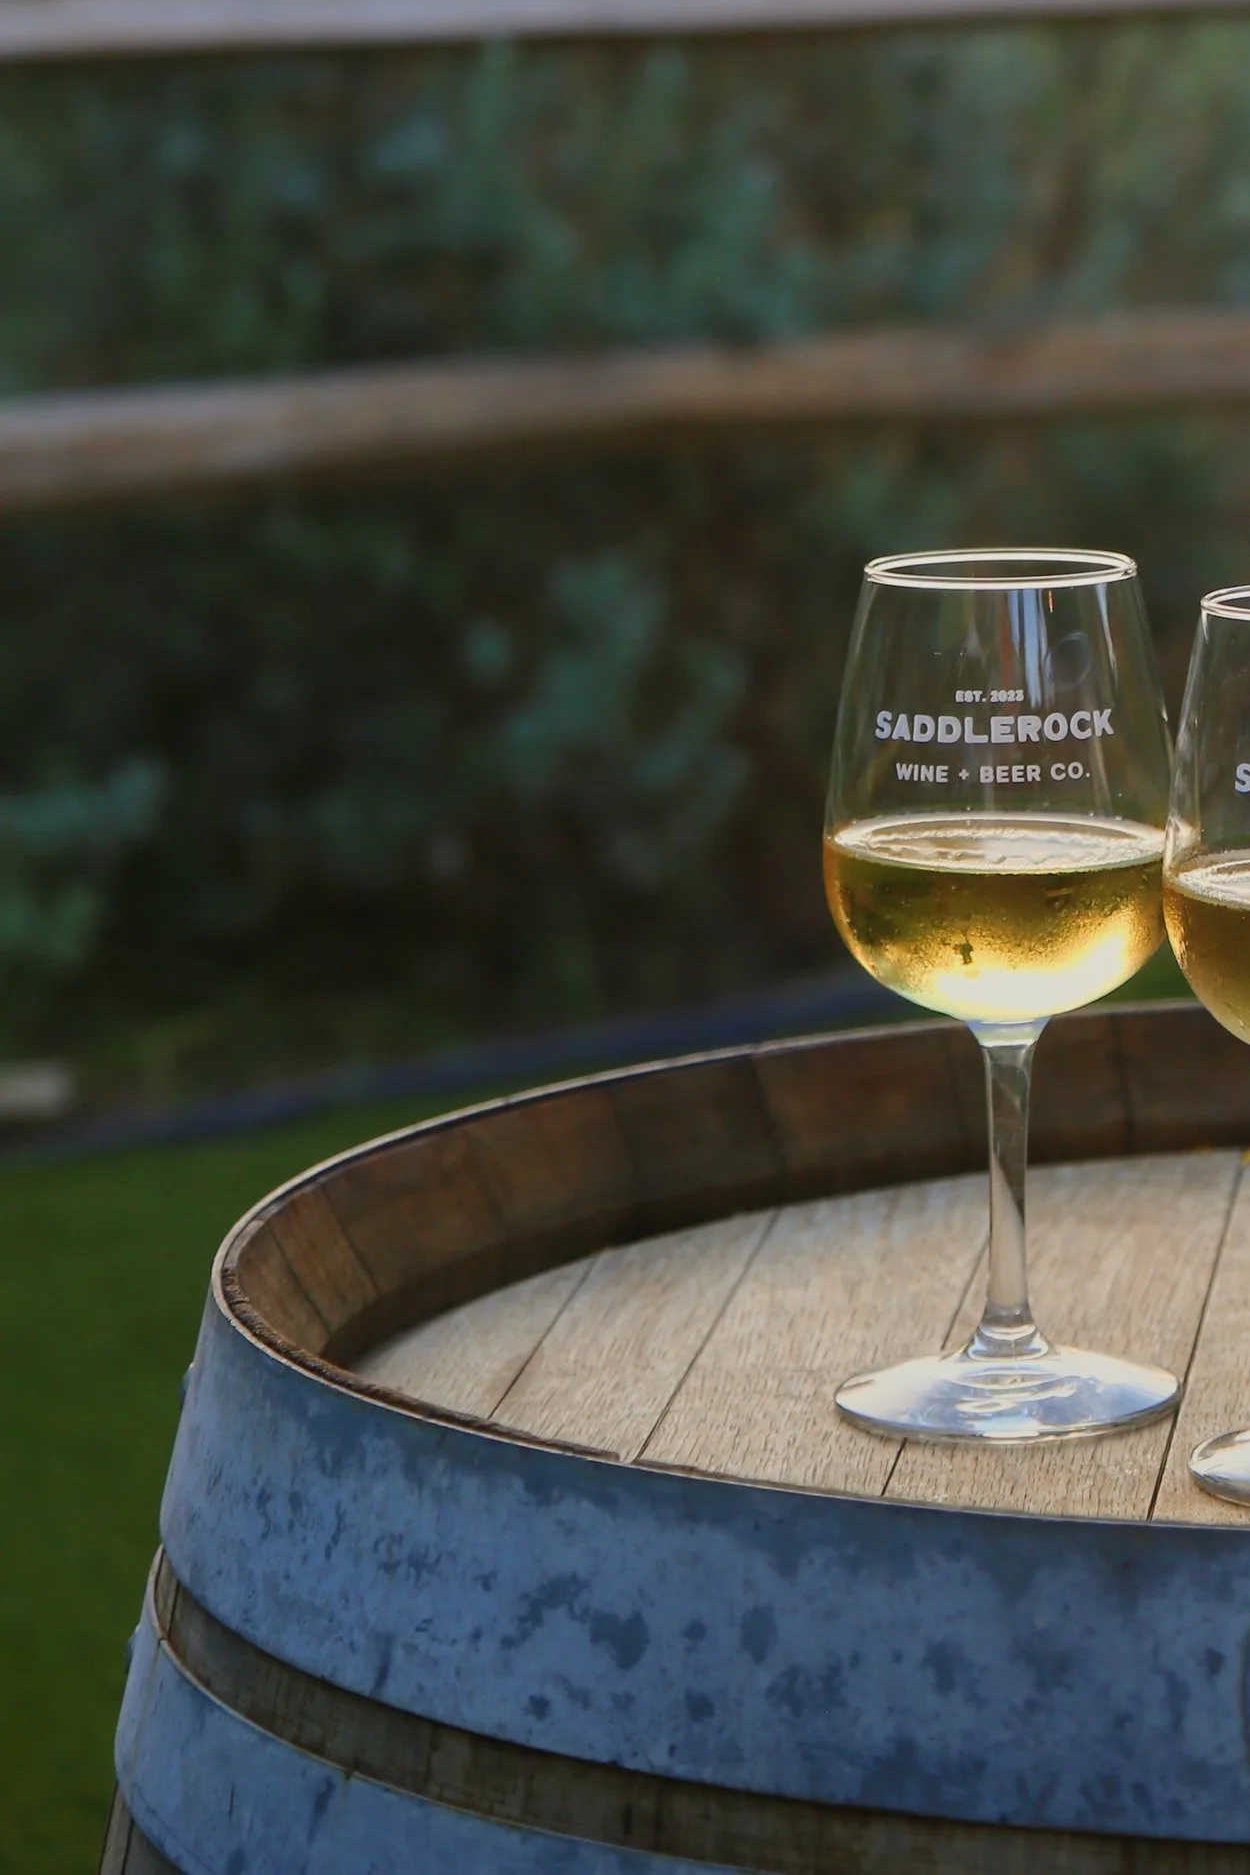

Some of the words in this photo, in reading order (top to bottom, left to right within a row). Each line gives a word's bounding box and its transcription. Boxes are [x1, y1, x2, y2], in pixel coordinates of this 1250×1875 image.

[954, 689, 987, 703] EST.
[990, 689, 1025, 703] 2023
[874, 707, 1115, 744] SADDLEROCK
[895, 762, 949, 783] WINE
[979, 764, 1042, 784] BEER
[1050, 761, 1091, 781] CO.
